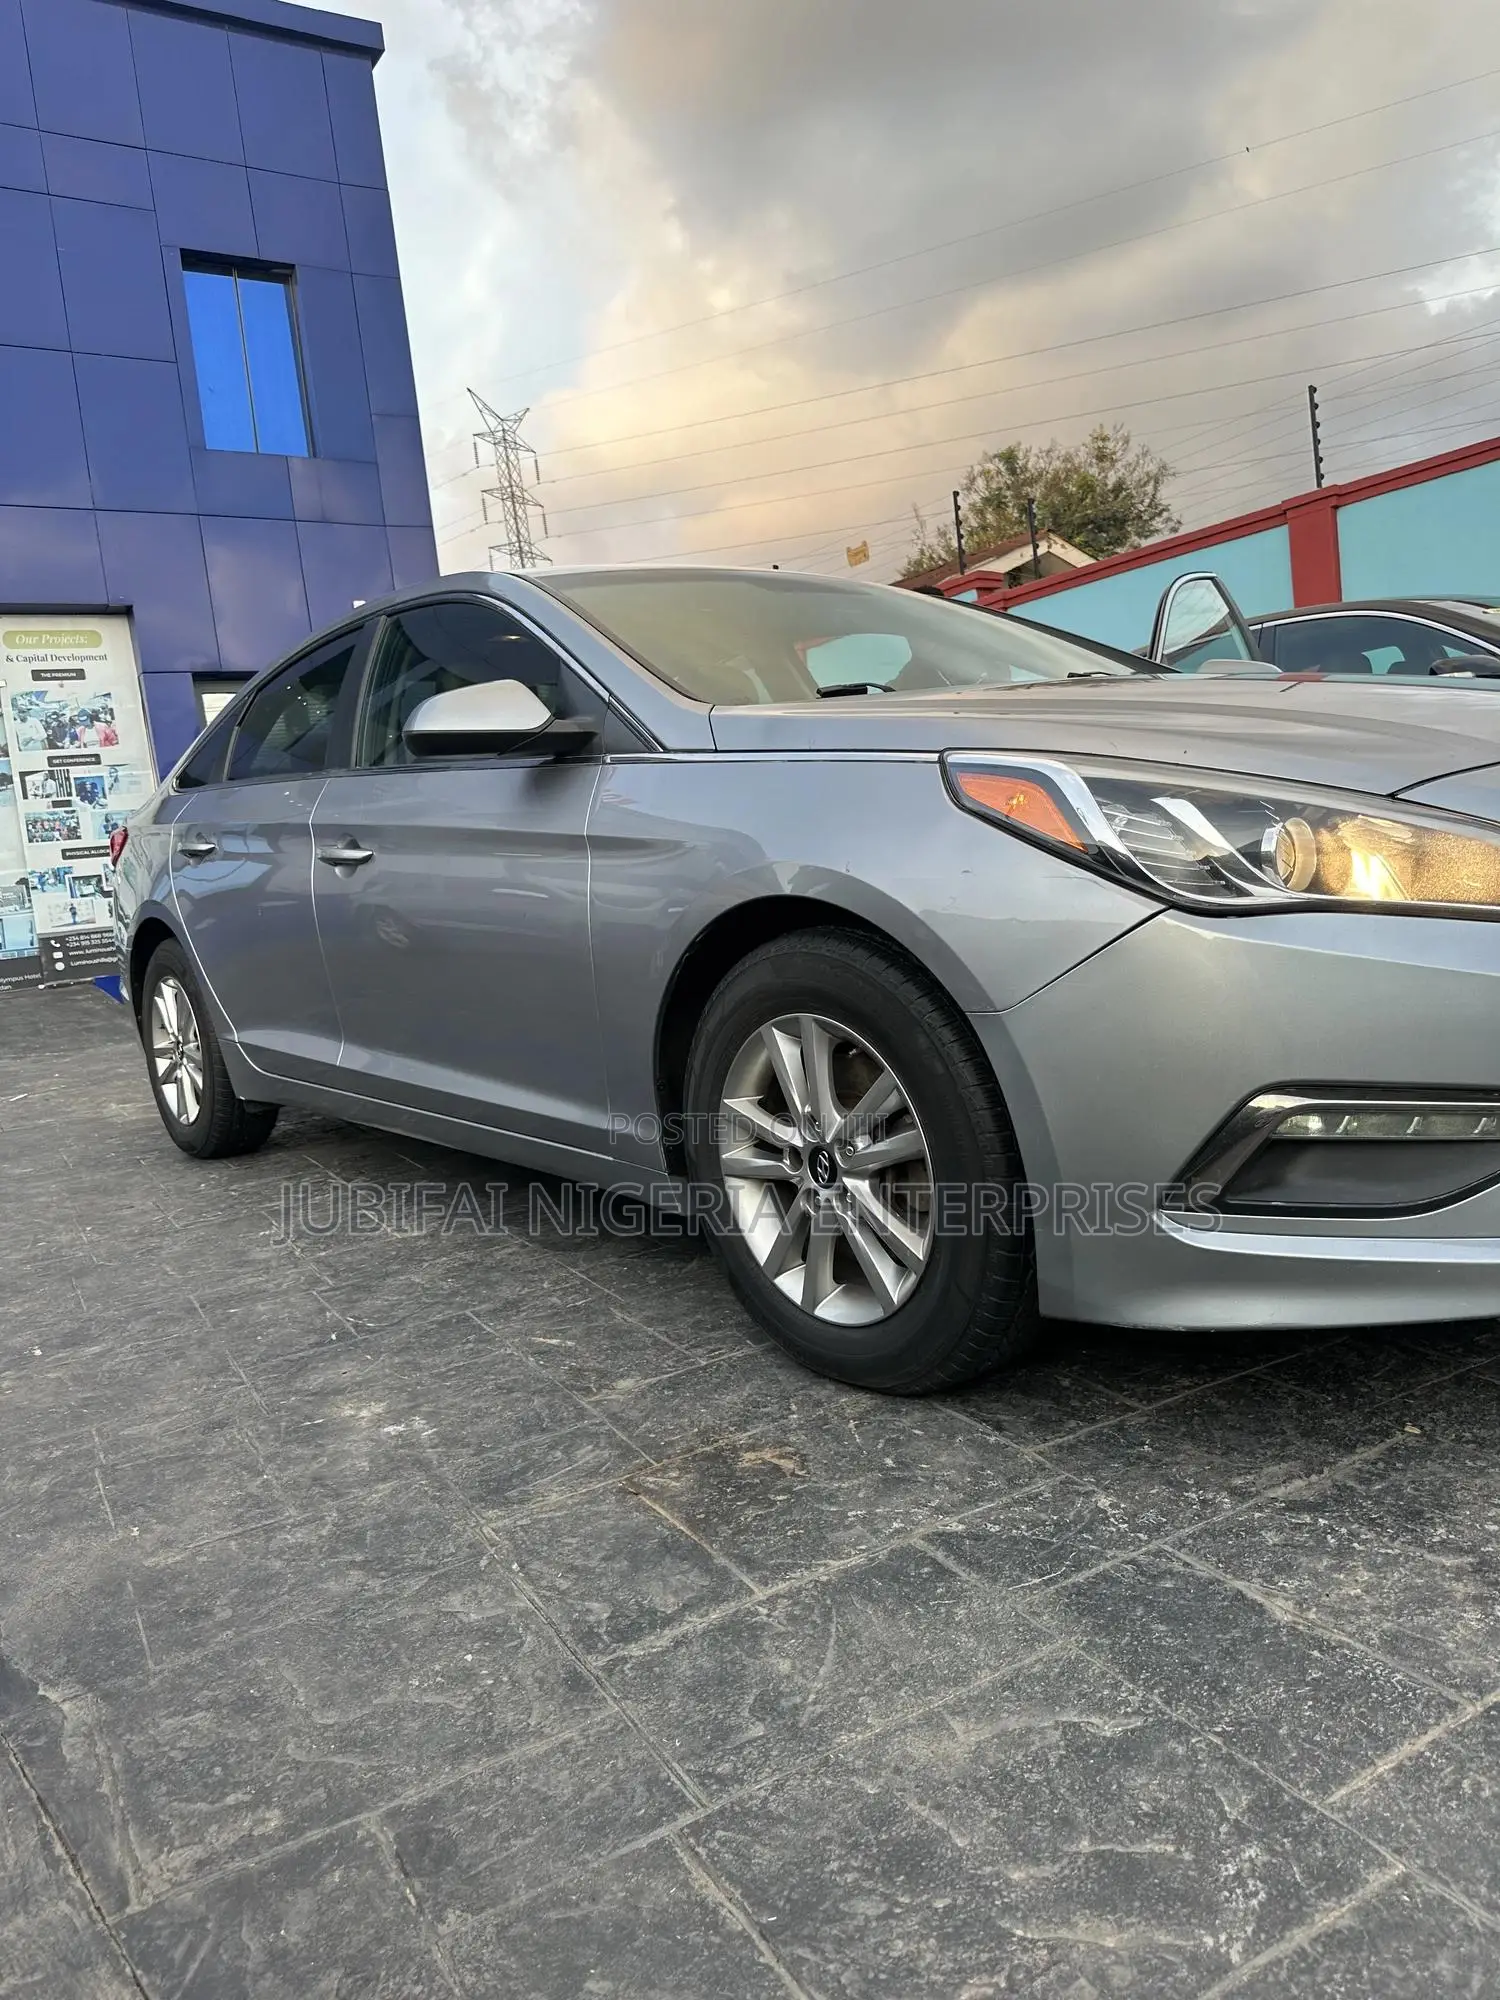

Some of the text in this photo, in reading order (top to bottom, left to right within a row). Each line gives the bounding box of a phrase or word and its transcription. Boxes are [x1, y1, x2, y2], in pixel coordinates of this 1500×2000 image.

[15, 633, 88, 646] Our Projects:
[5, 653, 108, 664] & Capital Development
